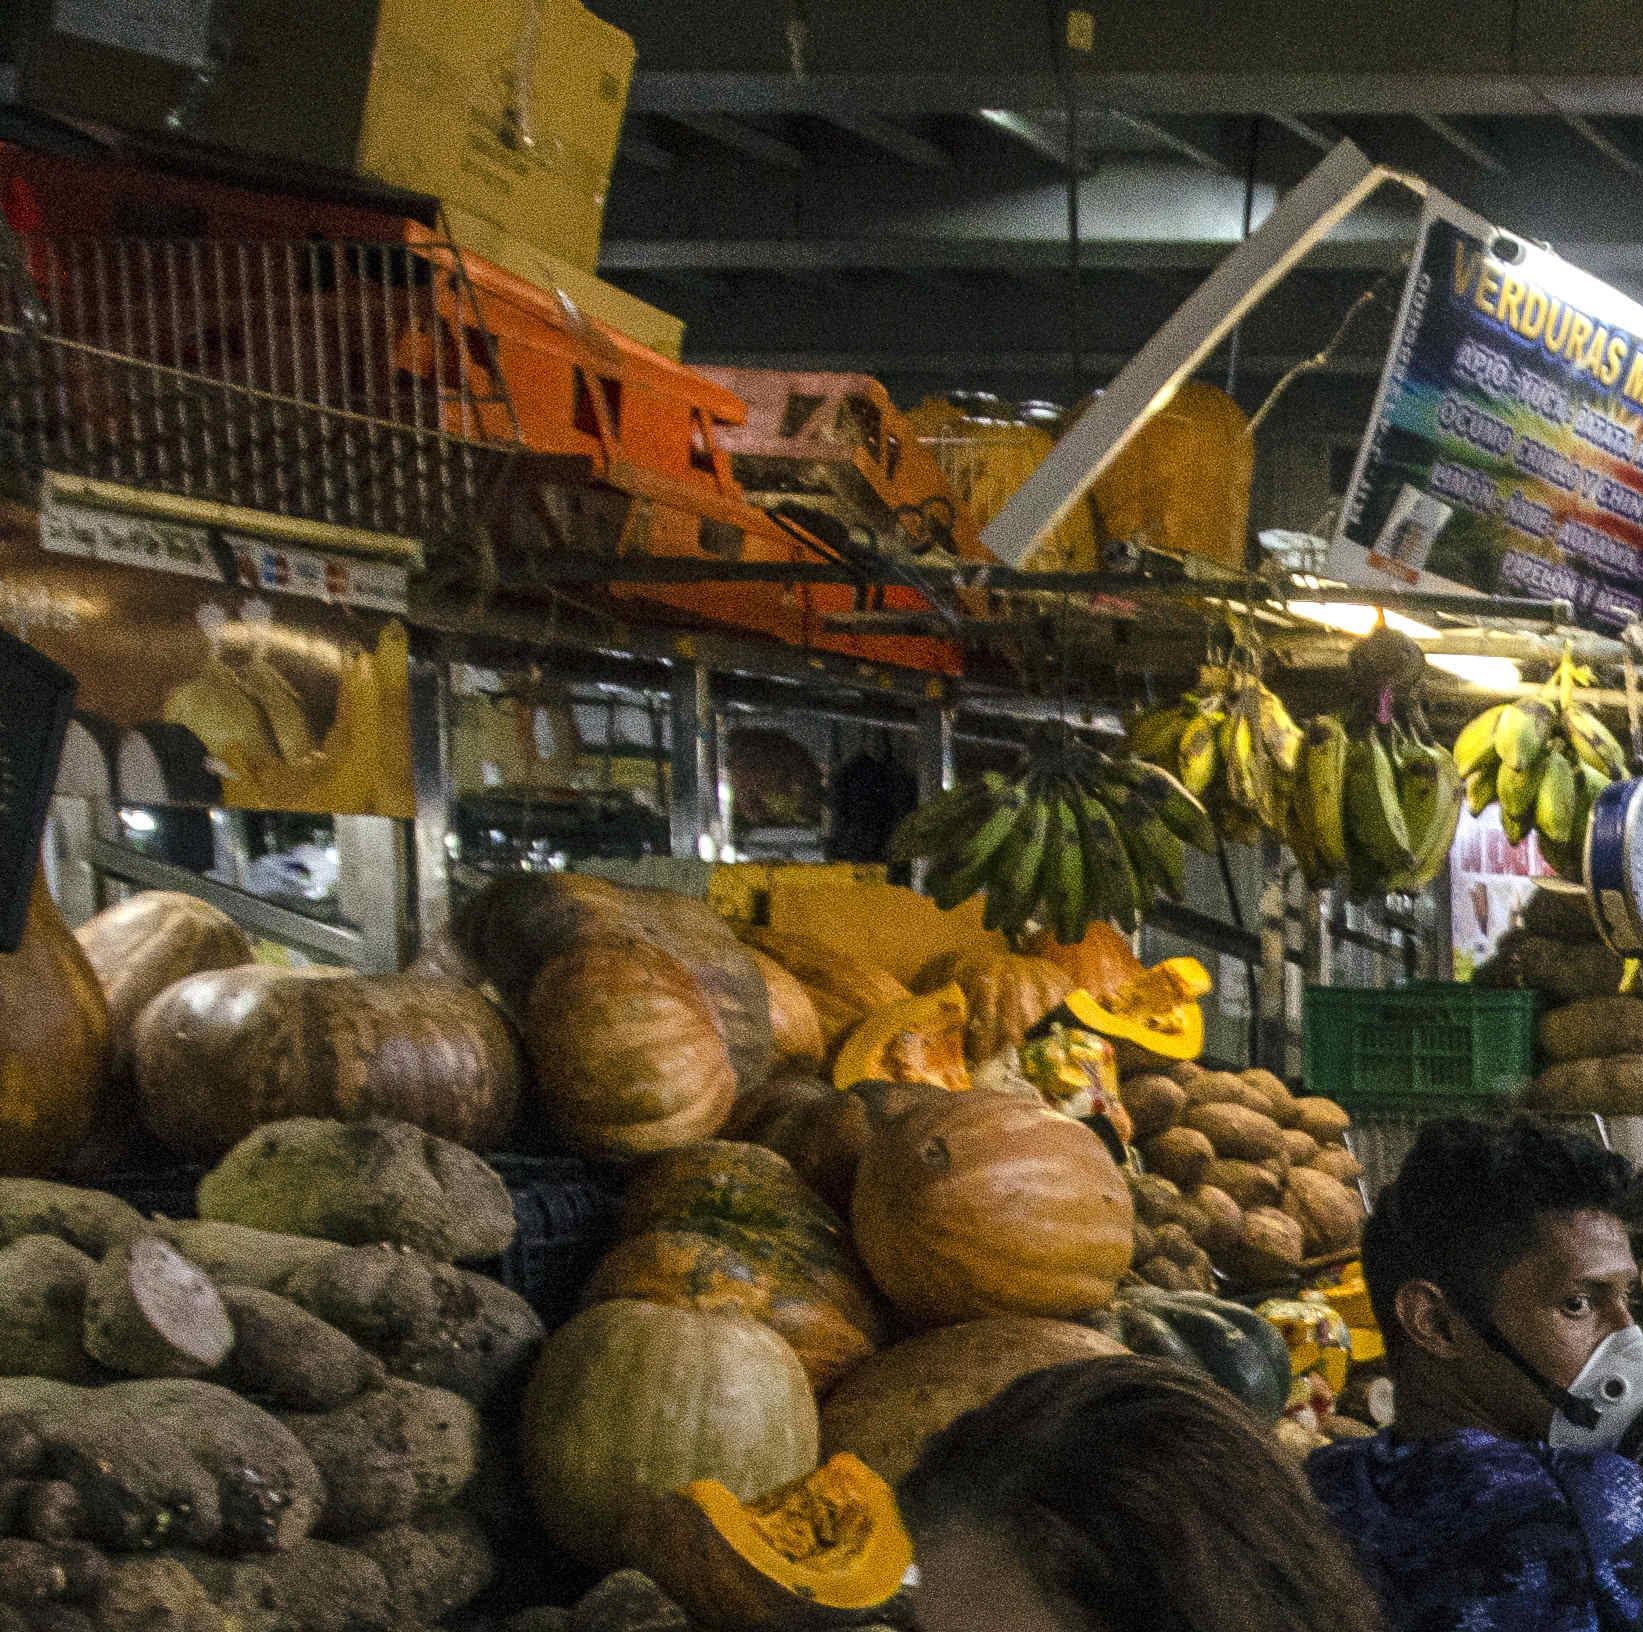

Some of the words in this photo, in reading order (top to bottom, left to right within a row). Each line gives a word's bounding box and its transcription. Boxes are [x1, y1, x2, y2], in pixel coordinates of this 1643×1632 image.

[1454, 239, 1629, 386] VERDURAS
[1456, 341, 1512, 389] APIO
[1438, 400, 1515, 453] OCUMO
